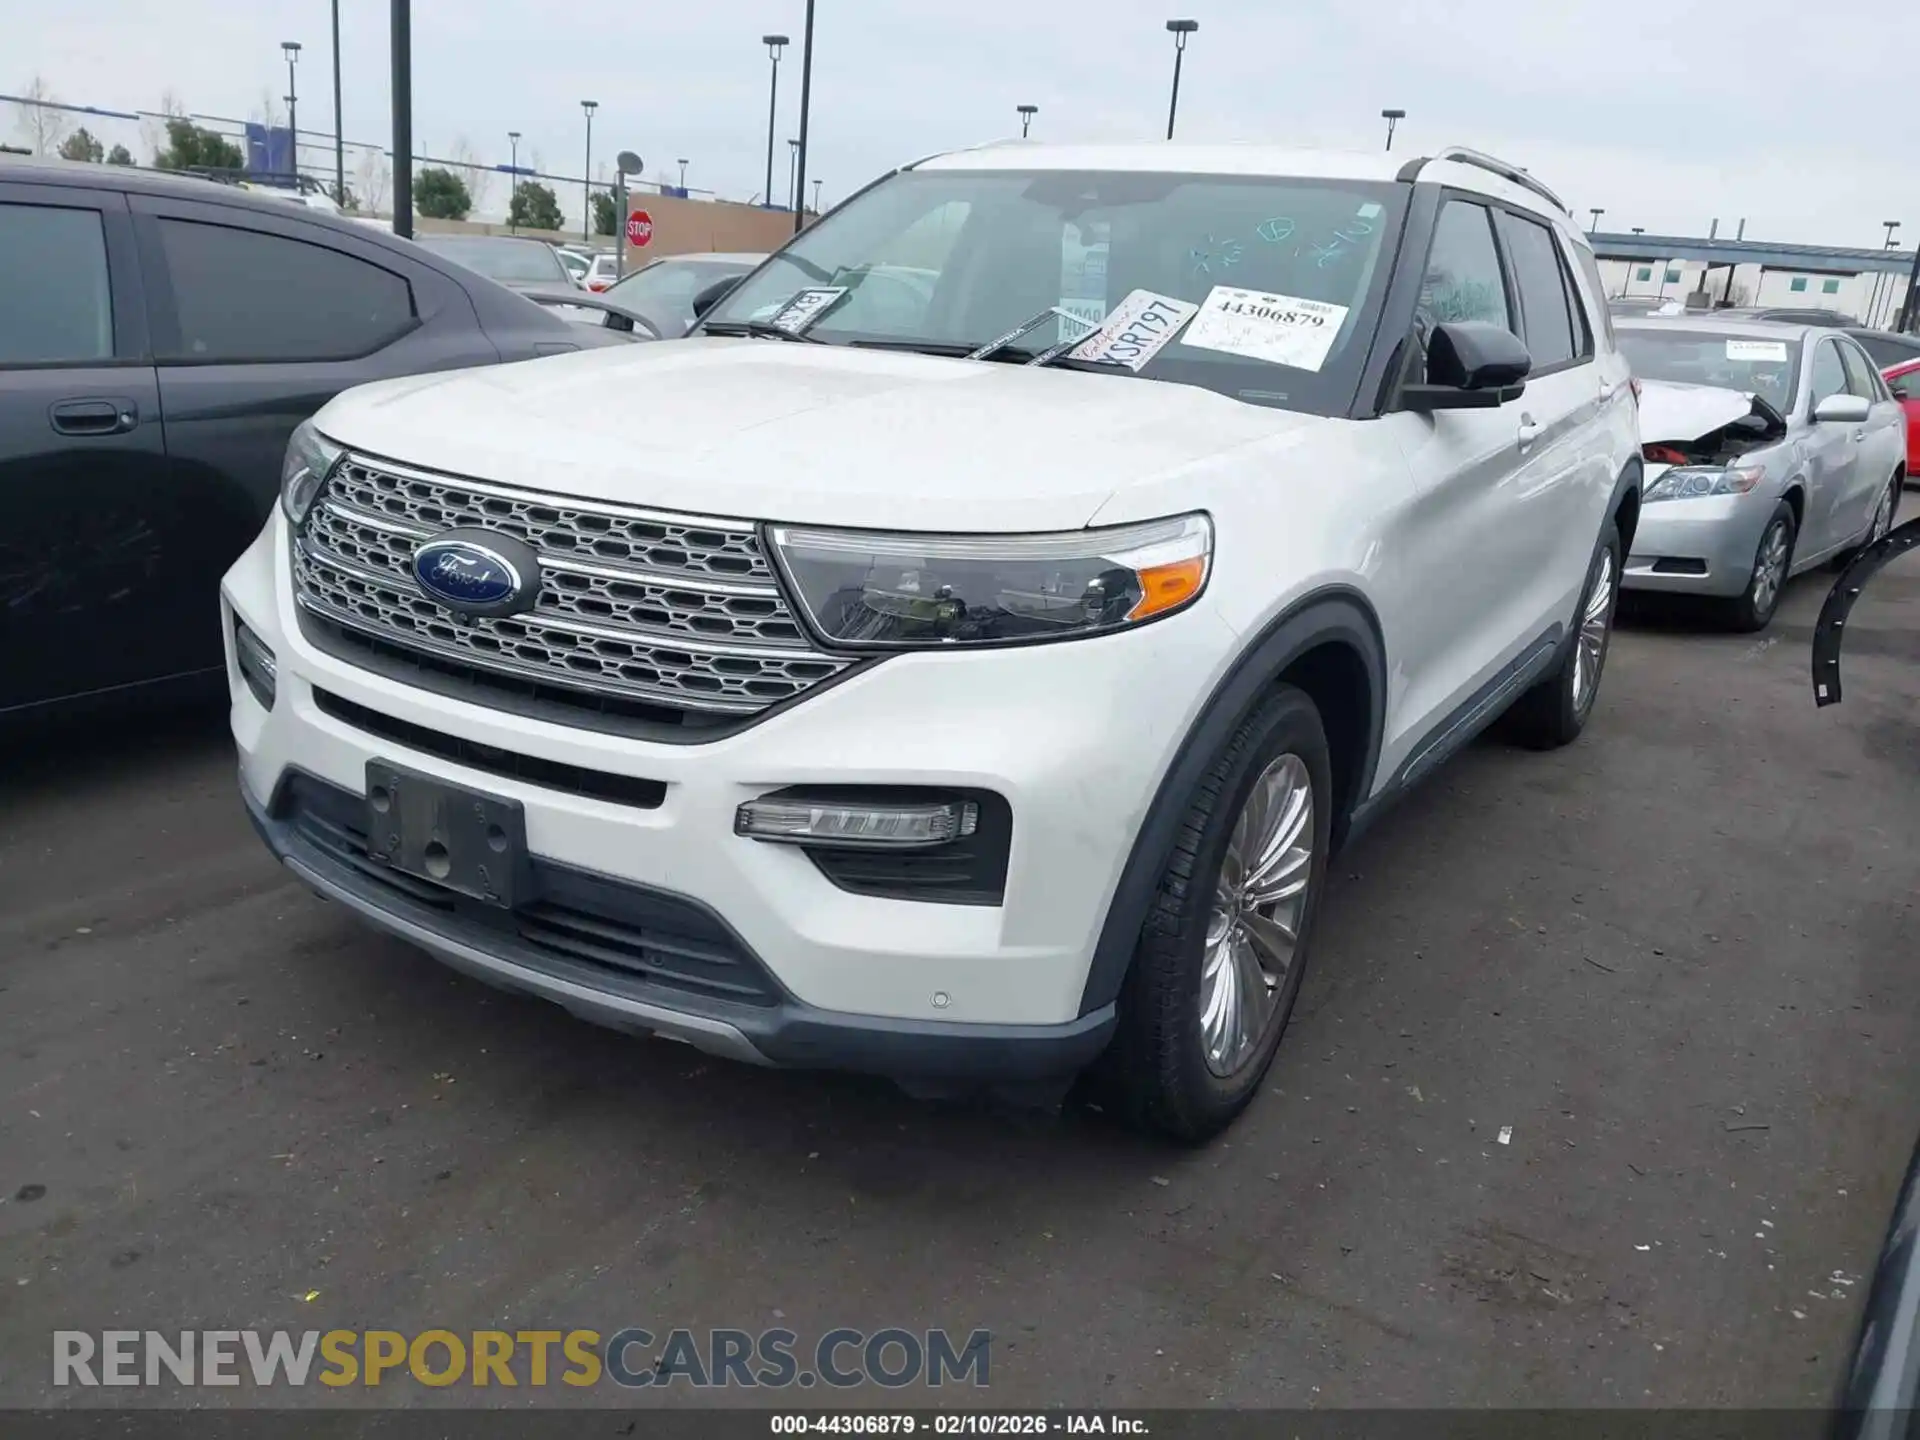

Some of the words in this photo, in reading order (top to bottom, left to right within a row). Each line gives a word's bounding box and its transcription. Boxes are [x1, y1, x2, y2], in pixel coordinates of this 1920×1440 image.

[627, 220, 652, 236] STOP
[1217, 300, 1325, 328] 44306879
[431, 552, 491, 592] Ford
